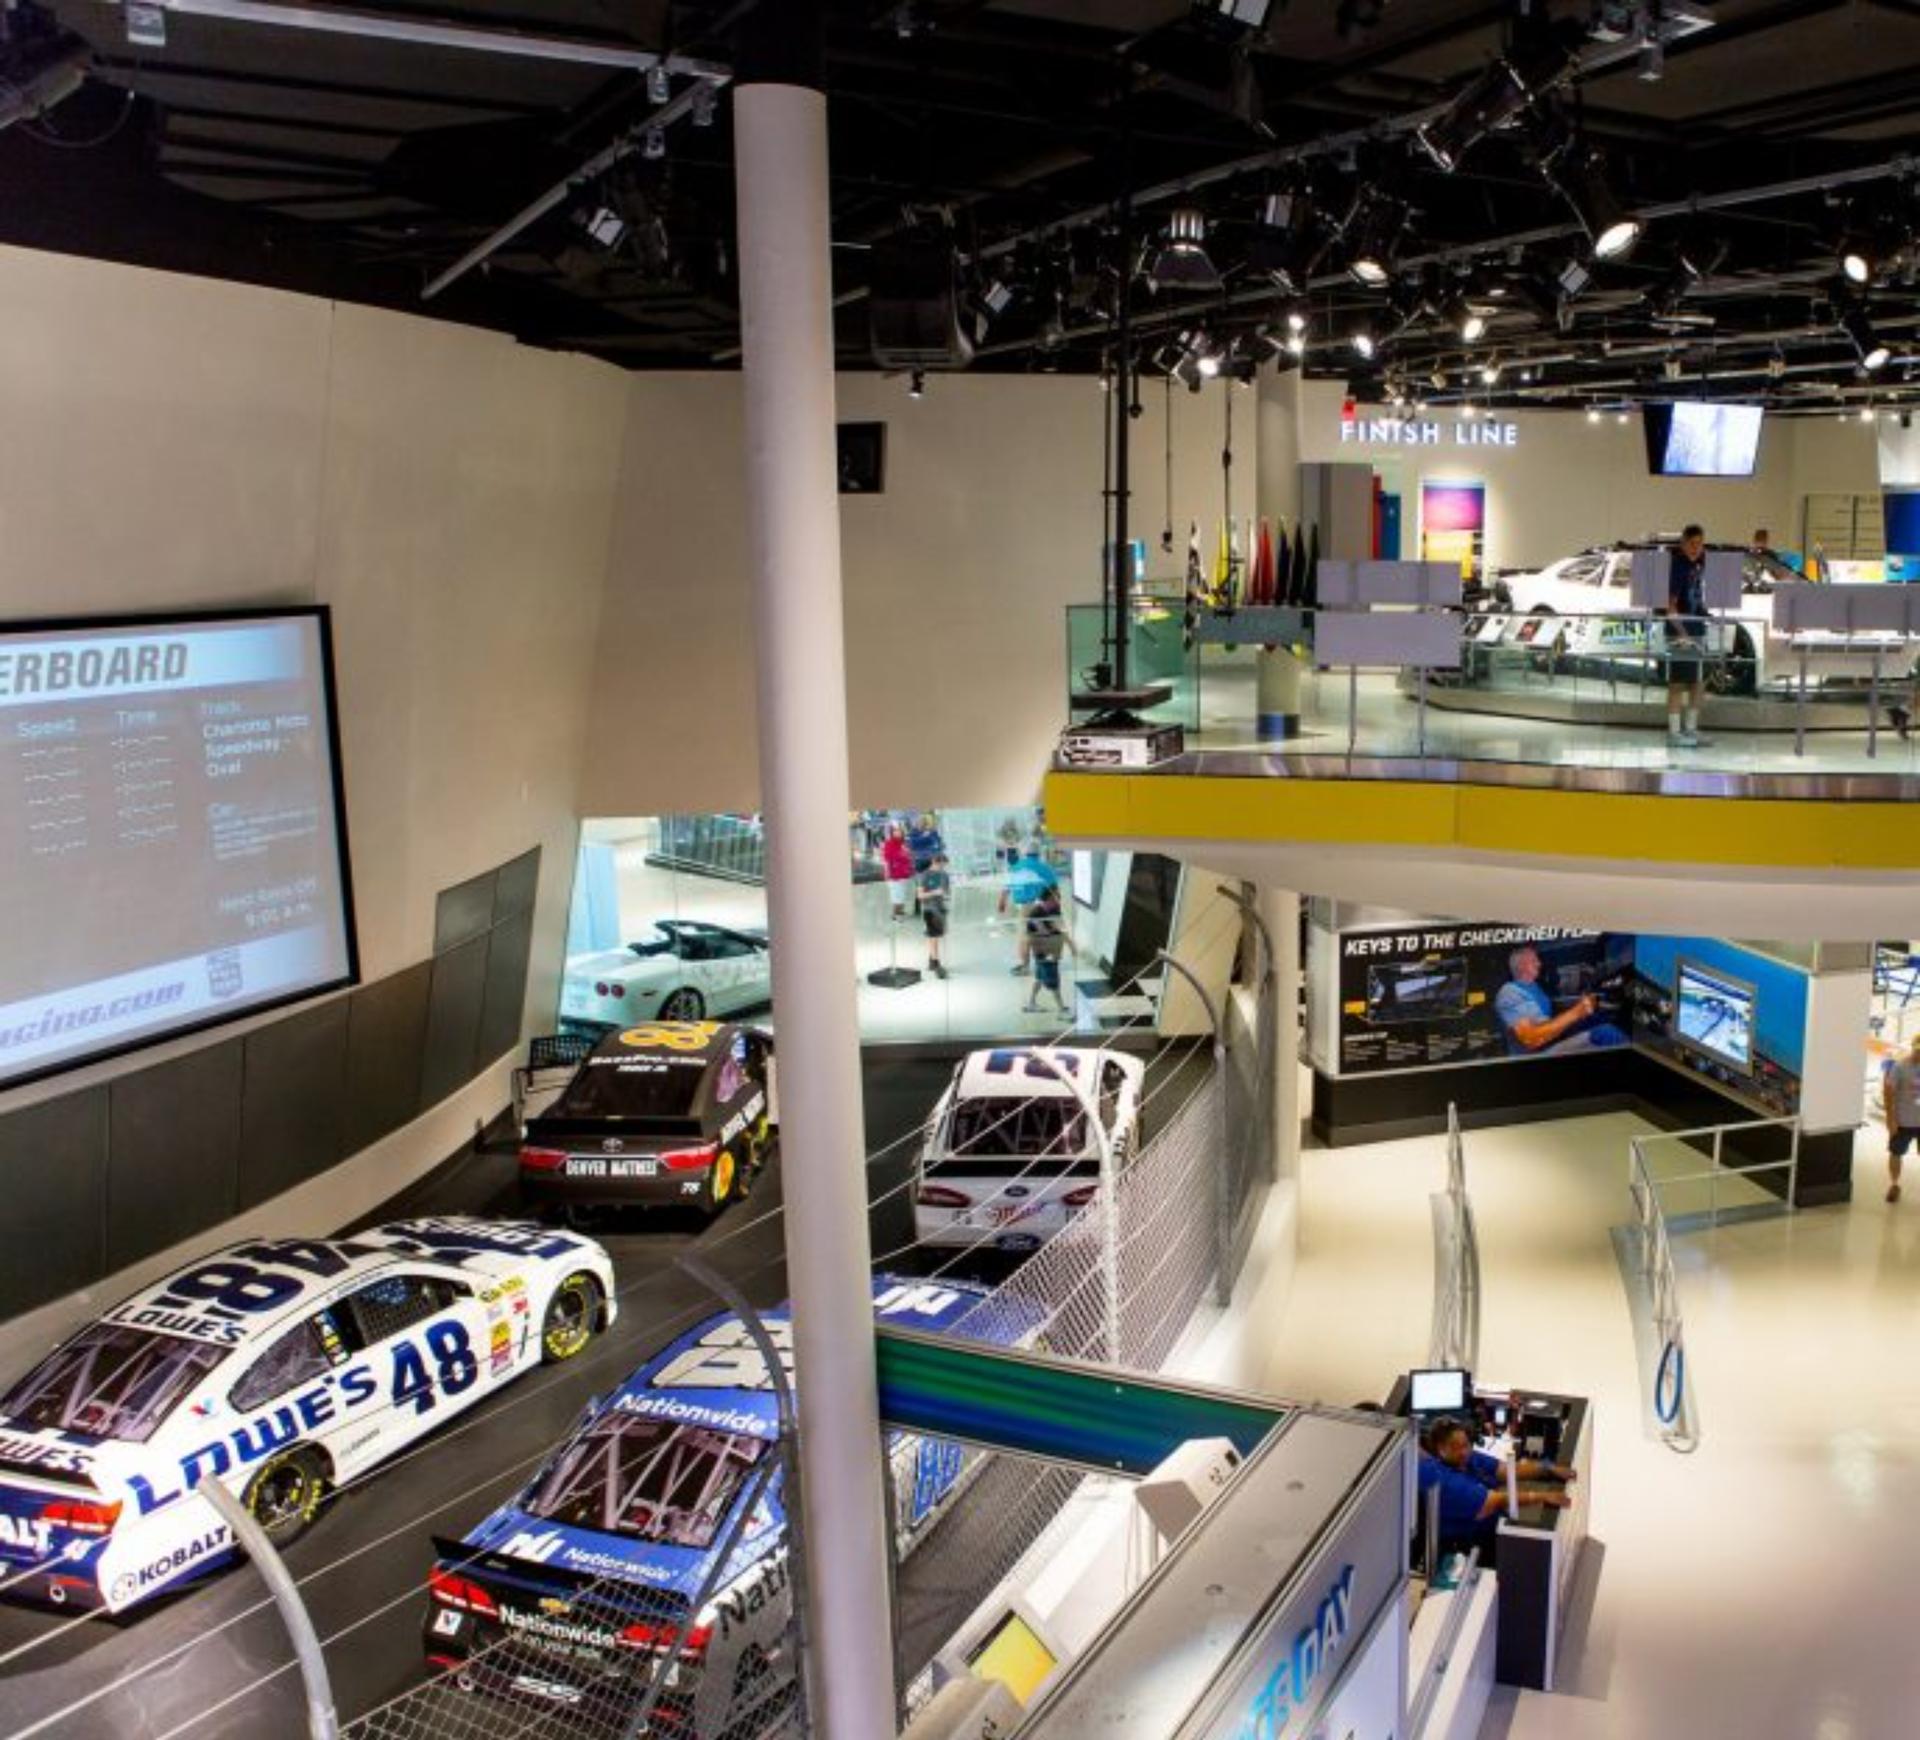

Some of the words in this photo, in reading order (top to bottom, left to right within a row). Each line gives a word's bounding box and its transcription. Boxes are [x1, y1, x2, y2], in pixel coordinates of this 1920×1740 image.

[1341, 419, 1439, 444] FINISH
[1456, 423, 1517, 445] LINE
[1345, 935, 1391, 957] KEYS
[1396, 933, 1419, 951] TO
[1424, 932, 1454, 948] THE
[1459, 926, 1559, 946] CHECKERED
[565, 1159, 607, 1175] DENVER
[110, 1304, 249, 1344] LOWE'S
[390, 1319, 479, 1417] 48
[614, 1393, 767, 1433] Nationwide
[126, 1365, 378, 1516] LOWE'S
[138, 1526, 228, 1586] KOBALT
[498, 1603, 618, 1648] Nationwide
